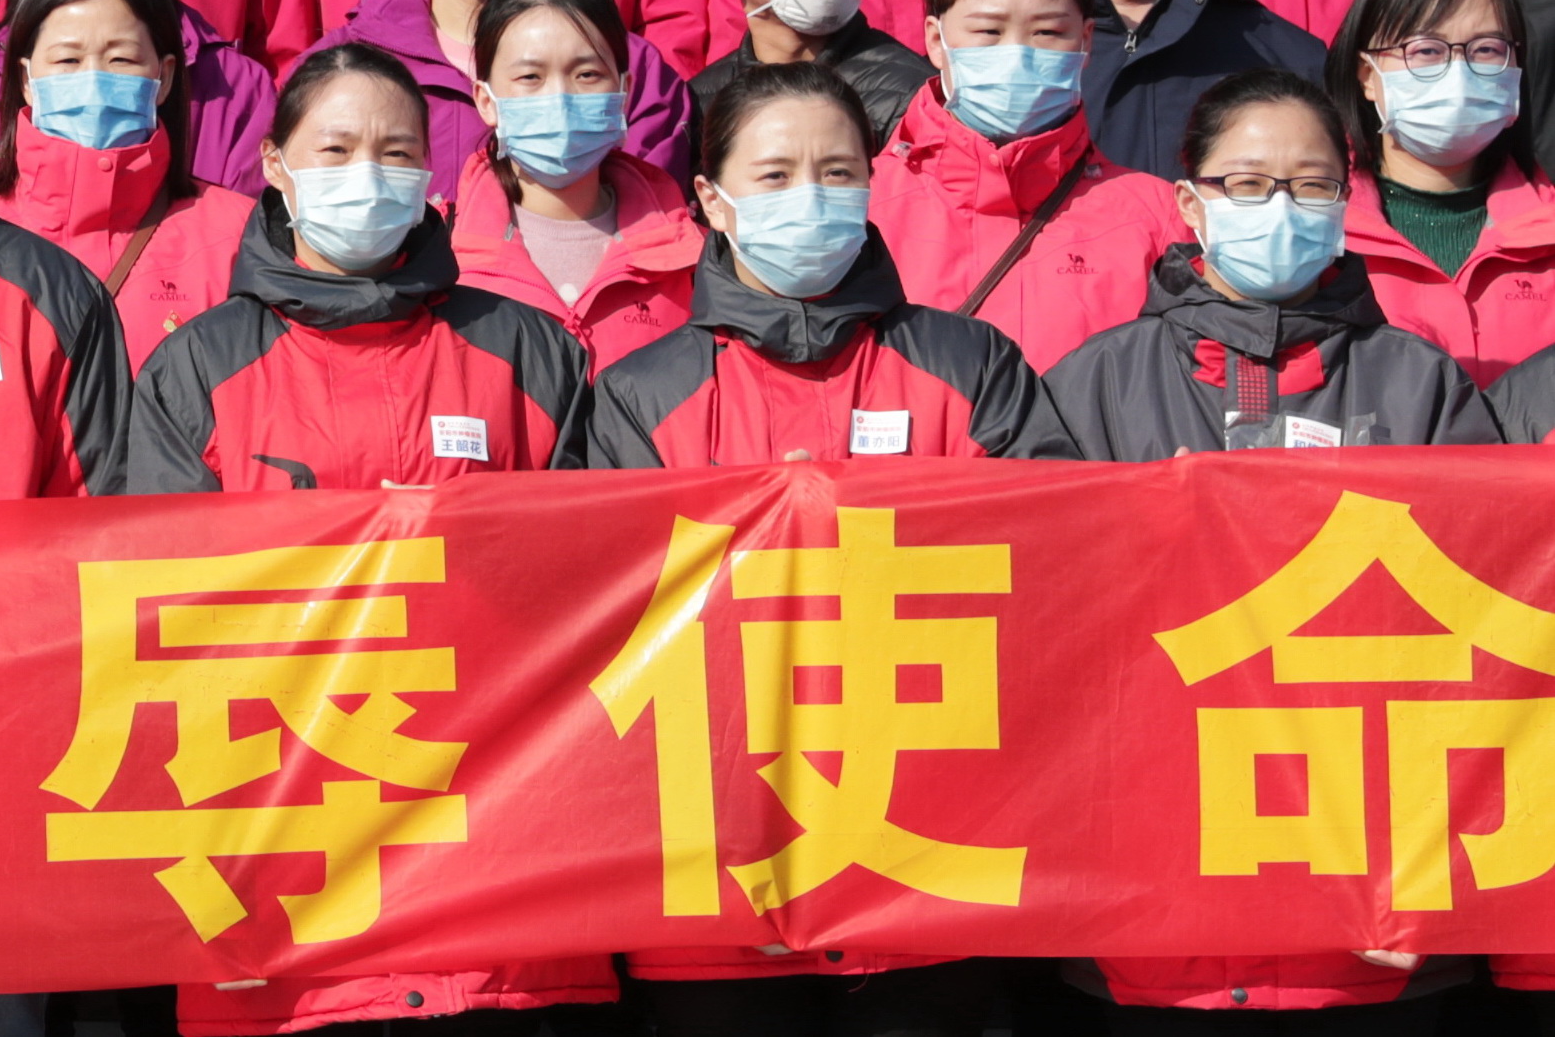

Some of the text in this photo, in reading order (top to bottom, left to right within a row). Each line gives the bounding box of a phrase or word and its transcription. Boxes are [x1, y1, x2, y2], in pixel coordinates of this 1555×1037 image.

[149, 293, 191, 301] CAMEL
[1505, 293, 1548, 301] CAMEL
[623, 314, 662, 327] CAMEL
